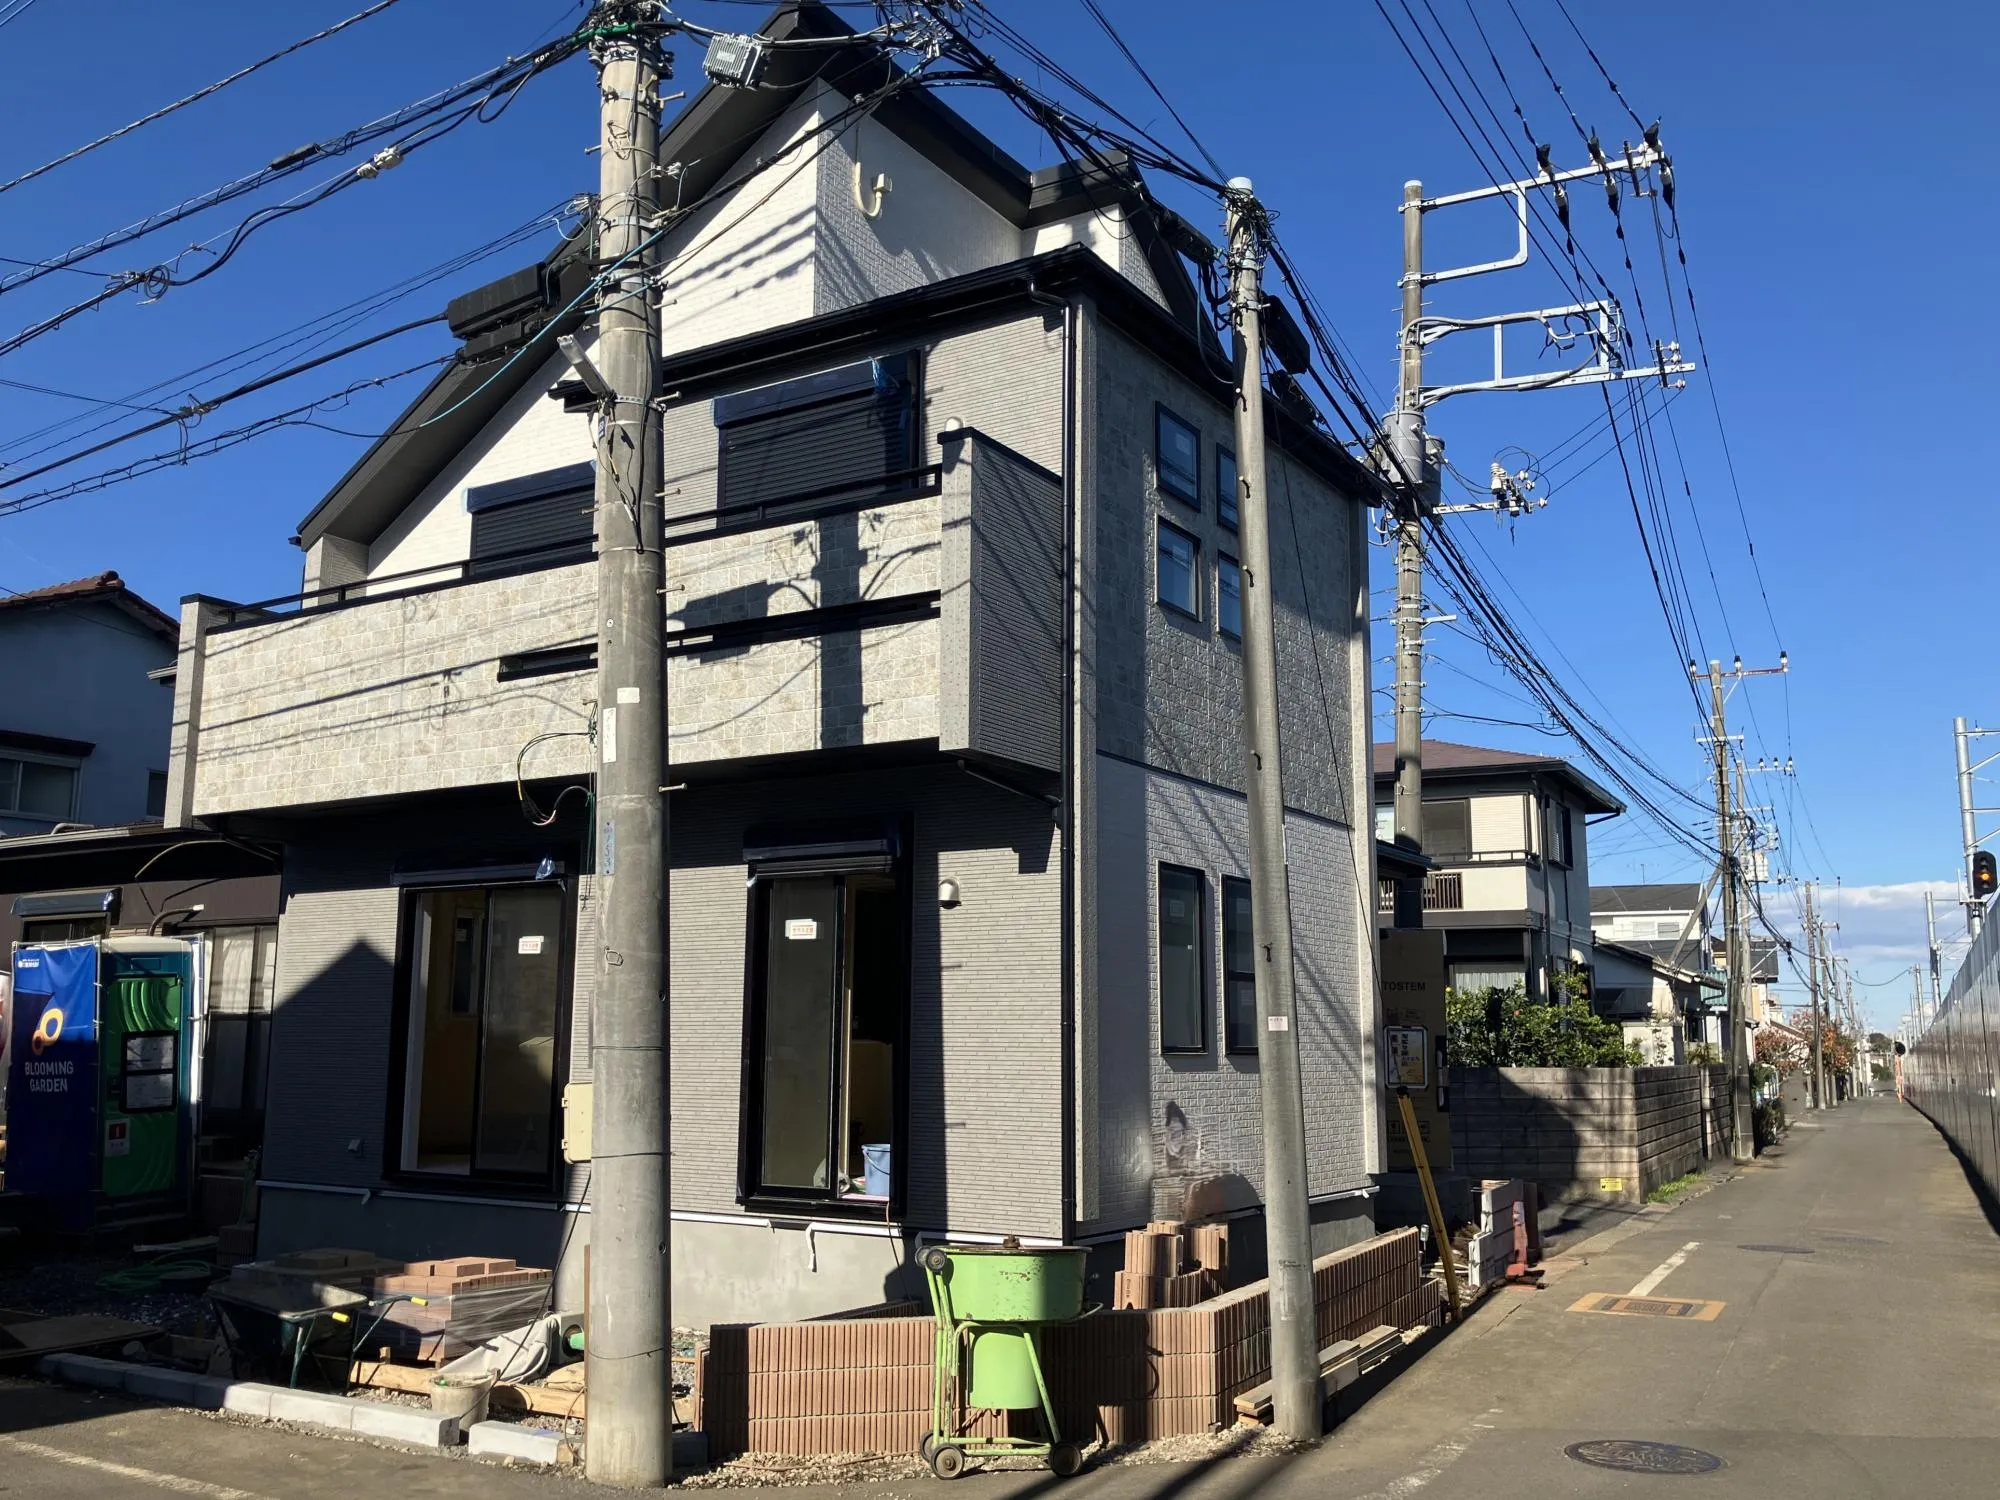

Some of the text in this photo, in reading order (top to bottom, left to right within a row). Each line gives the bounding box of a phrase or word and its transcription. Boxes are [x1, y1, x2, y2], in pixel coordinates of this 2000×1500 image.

[1383, 980, 1426, 991] TOSTEM
[24, 1060, 74, 1076] BLOOMING
[30, 1078, 68, 1092] GARDEN
